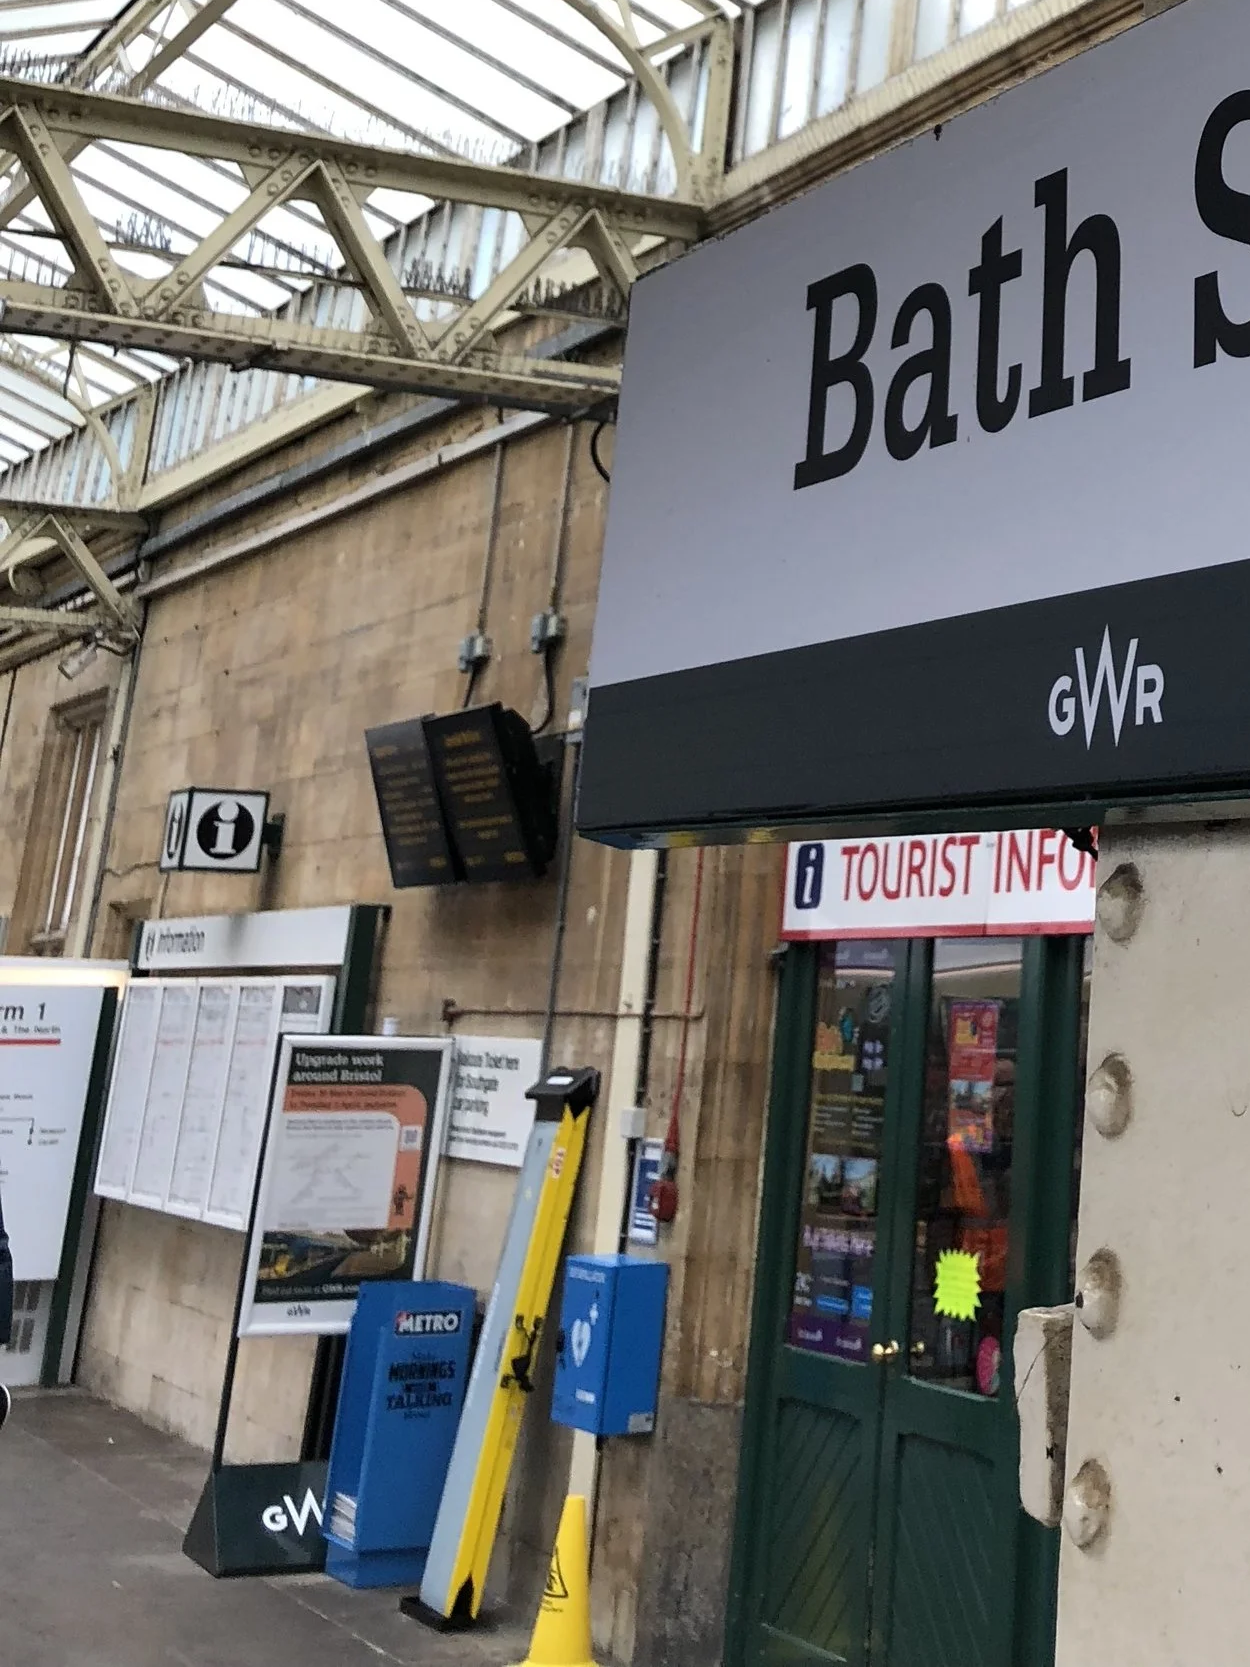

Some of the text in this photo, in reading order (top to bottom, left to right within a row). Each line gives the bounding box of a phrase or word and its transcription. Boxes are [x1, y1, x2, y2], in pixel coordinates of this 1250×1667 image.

[793, 166, 1131, 491] Bath
[1048, 623, 1165, 750] GWR
[840, 834, 980, 902] TOURIST
[38, 1002, 47, 1021] 1
[295, 1052, 385, 1067] Upgrade work
[292, 1069, 383, 1083] around Bristol
[398, 1311, 459, 1333] METRO
